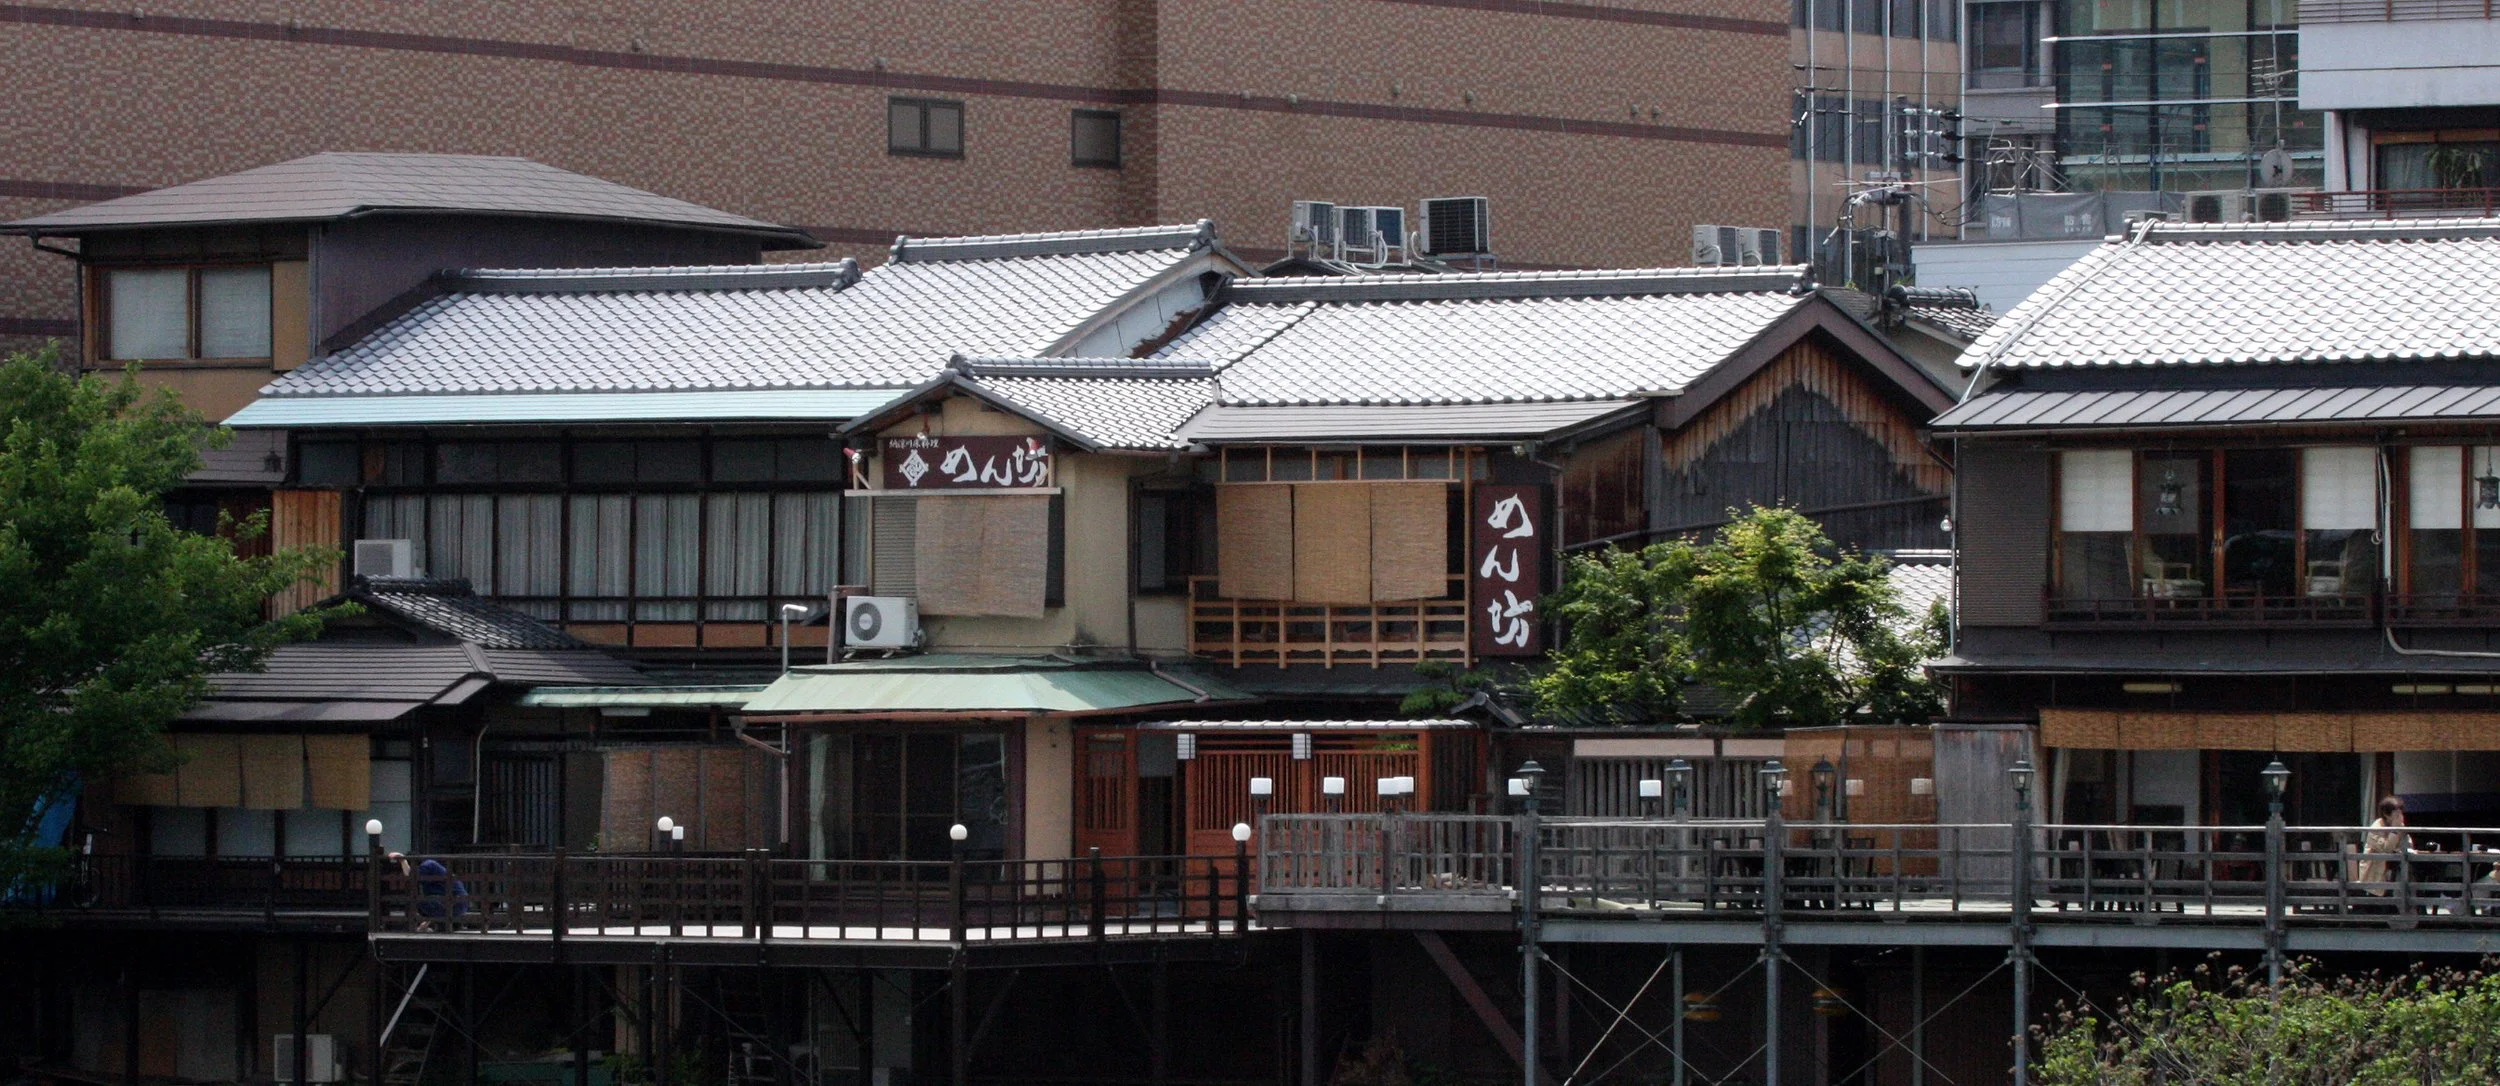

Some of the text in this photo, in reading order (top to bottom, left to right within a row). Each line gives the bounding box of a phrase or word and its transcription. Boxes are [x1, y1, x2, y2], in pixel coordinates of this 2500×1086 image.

[940, 437, 1049, 487] めん坊
[1480, 493, 1533, 648] めん坊
